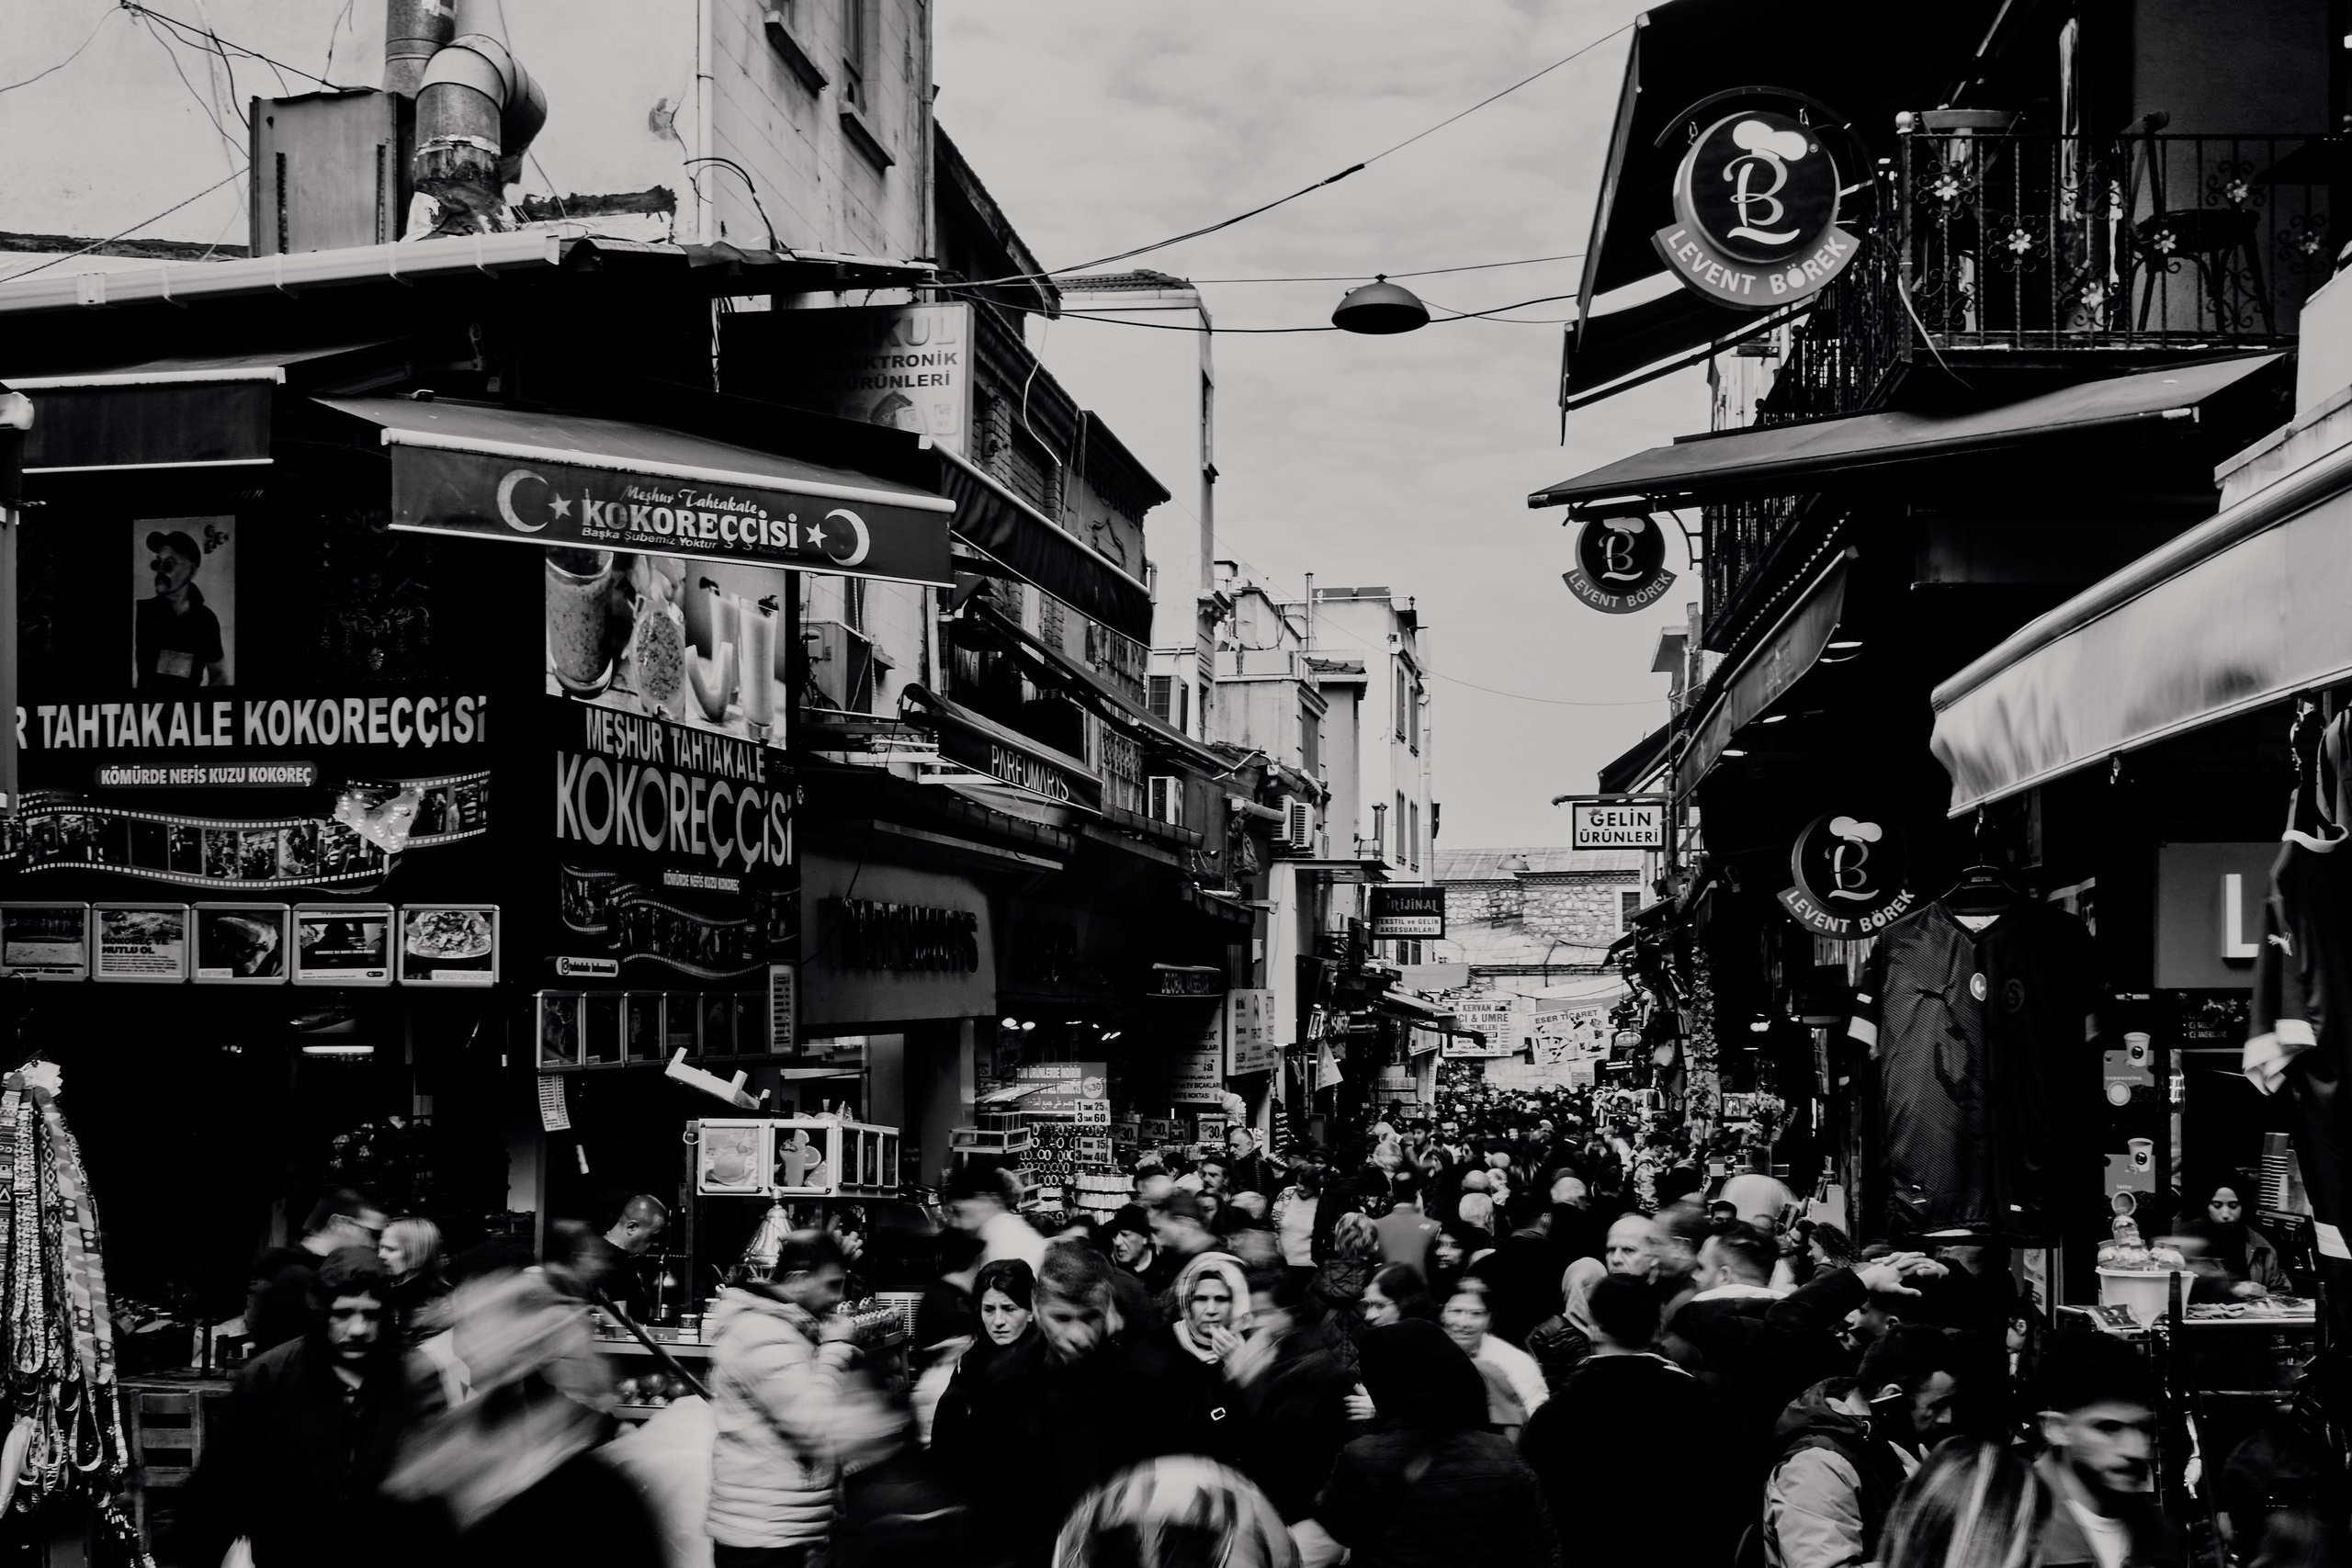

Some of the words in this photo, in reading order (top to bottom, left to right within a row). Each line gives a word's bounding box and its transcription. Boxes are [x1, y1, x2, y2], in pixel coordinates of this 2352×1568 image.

[1667, 230, 1756, 294] LEVENT
[1770, 236, 1848, 295] BÖREK
[622, 485, 674, 507] Meşhur
[678, 489, 758, 514] Tahtakale
[581, 492, 798, 550] KOKOREÇÇİSİ
[582, 527, 620, 541] Başka
[624, 531, 675, 547] Şubemiz
[679, 536, 717, 549] Yoktur
[1568, 573, 1620, 607] LEVENT
[1626, 573, 1671, 607] BÖREK
[37, 700, 232, 749] TAHTAKALE
[243, 694, 488, 749] KOKOREÇÇİSİ
[585, 706, 663, 763] MEŞHUR
[670, 726, 766, 784] TAHTAKALE
[101, 765, 167, 784] KÖMÜRDE
[169, 763, 207, 784] NEFİS
[209, 765, 246, 784] KUZU
[248, 764, 312, 787] KOKOREÇ
[556, 750, 792, 873] KOKOREÇÇİSİ
[1590, 808, 1651, 827] GELİN
[1579, 829, 1657, 842] ÜRÜNLERİ
[1786, 891, 1850, 933] LEVENT
[1859, 889, 1915, 932] BÖREK
[1481, 1013, 1509, 1021] UMRE
[1535, 1015, 1558, 1024] ESER
[1077, 1113, 1083, 1122] 3
[1094, 1113, 1106, 1122] 60
[1094, 1102, 1104, 1111] 25
[1076, 1150, 1082, 1160] 3
